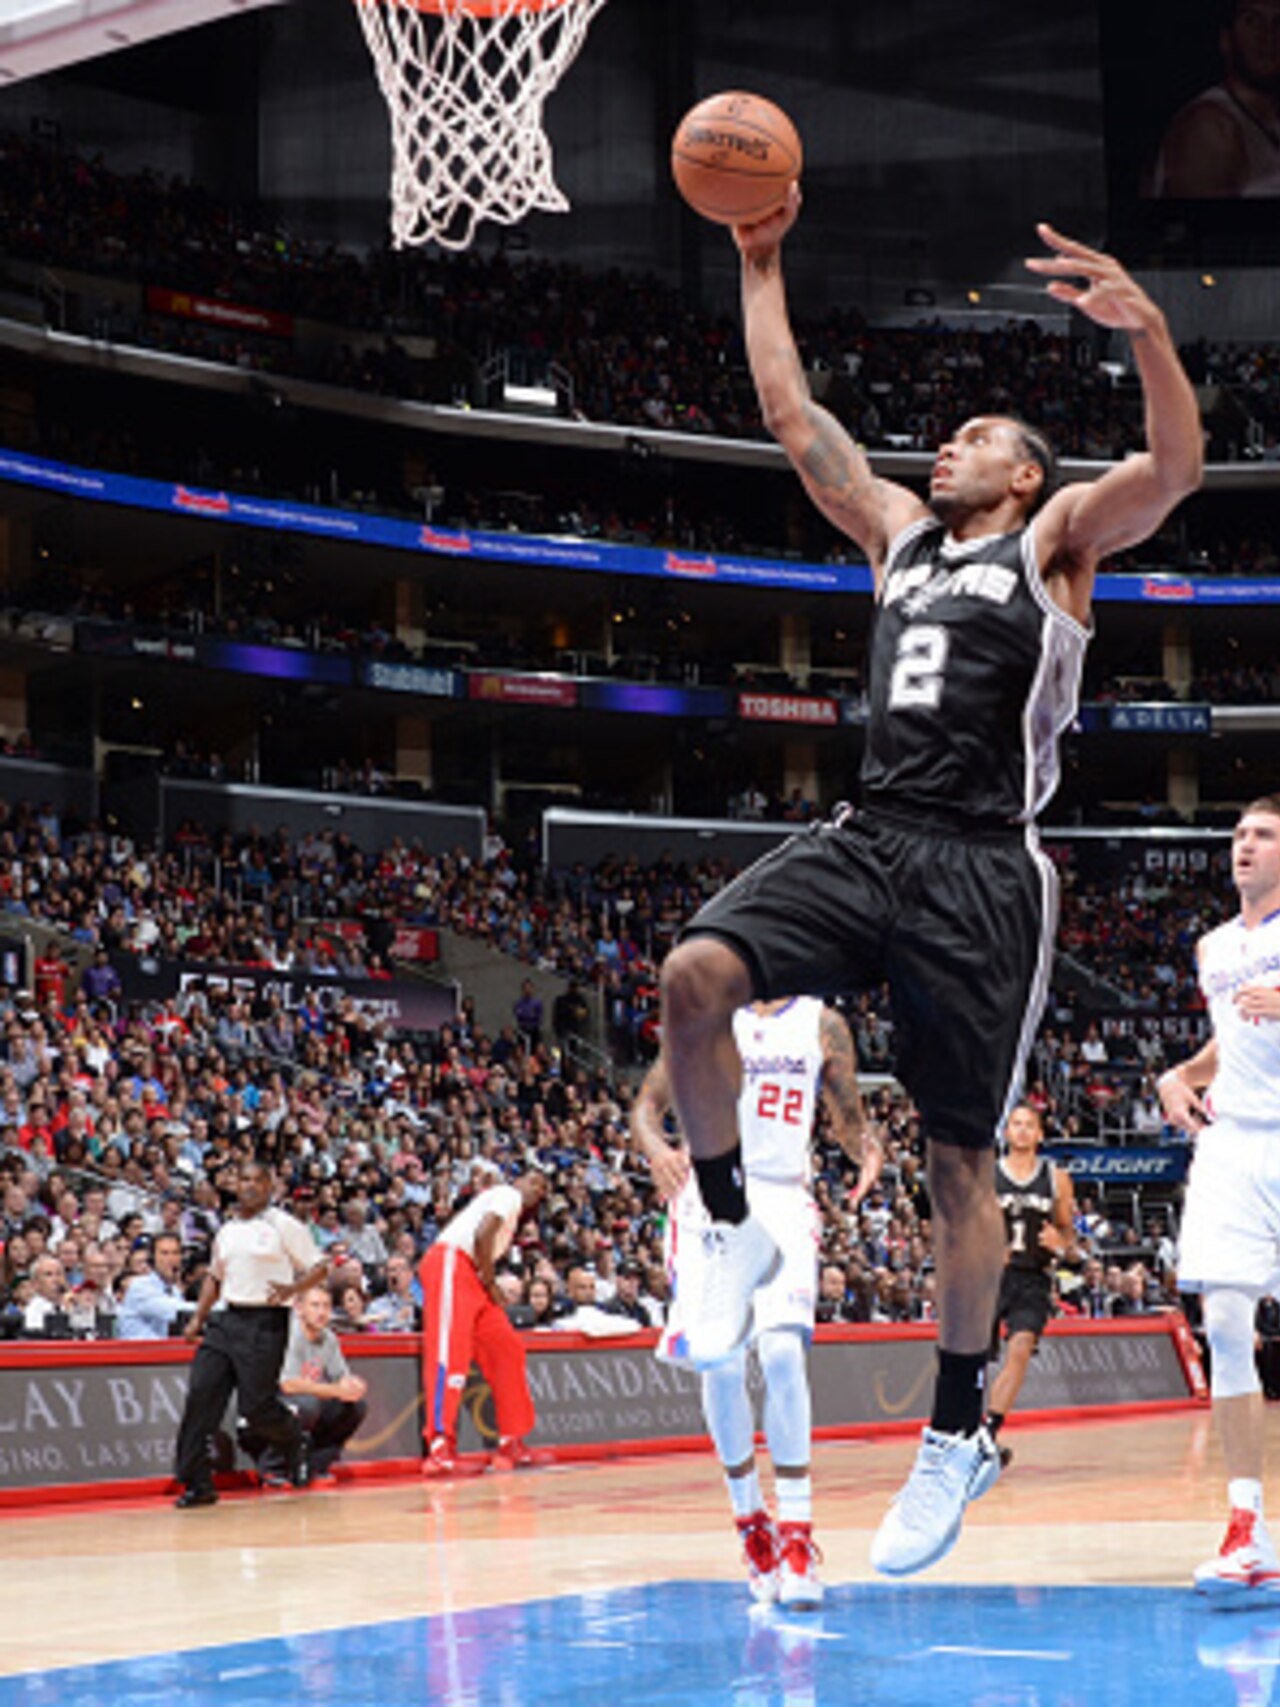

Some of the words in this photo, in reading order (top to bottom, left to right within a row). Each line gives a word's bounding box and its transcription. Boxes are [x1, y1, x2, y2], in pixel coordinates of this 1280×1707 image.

[888, 623, 951, 711] 2
[742, 697, 838, 722] TOSHIBA
[1136, 710, 1208, 731] DELTA
[757, 1082, 805, 1126] 22
[1011, 1220, 1027, 1251] 1
